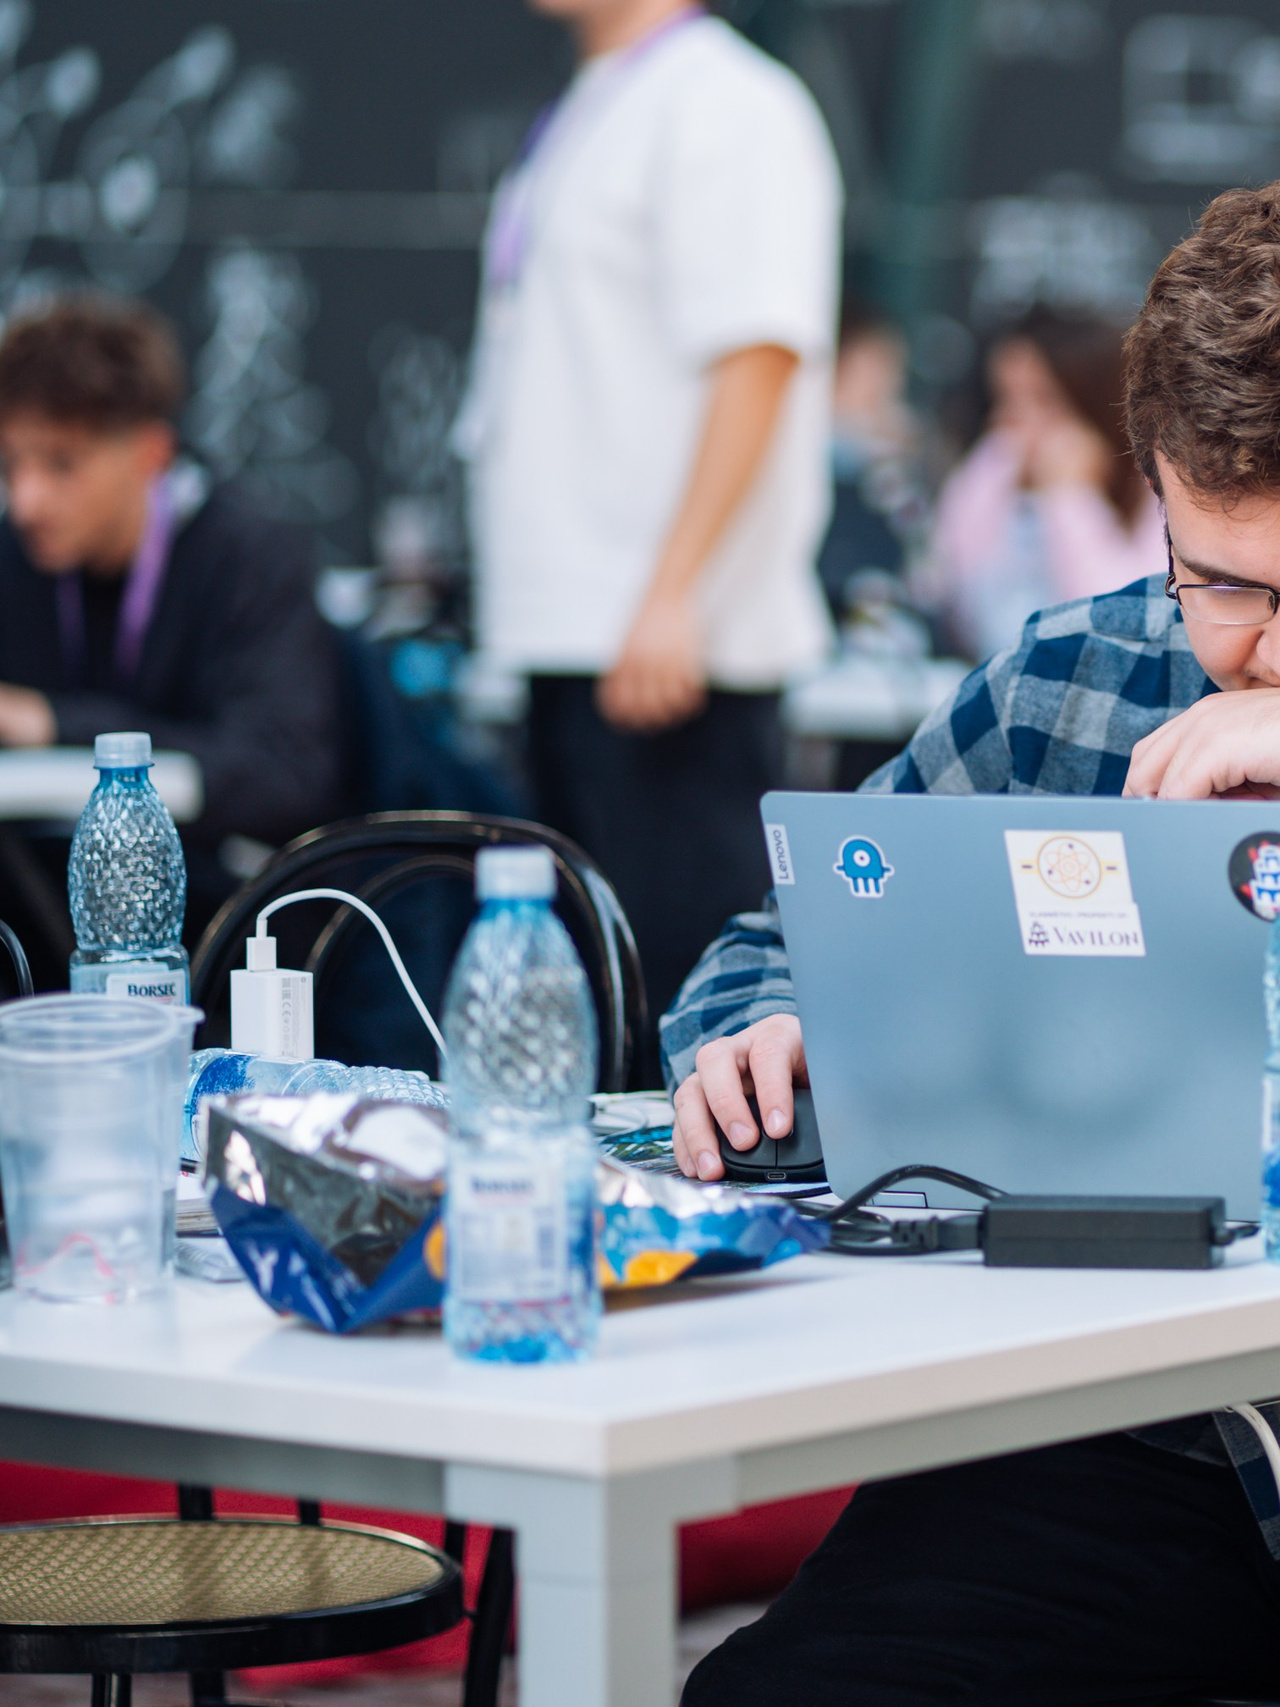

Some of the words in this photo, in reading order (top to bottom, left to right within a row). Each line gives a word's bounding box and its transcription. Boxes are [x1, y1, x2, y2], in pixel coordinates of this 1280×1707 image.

[773, 829, 789, 880] Lenovo
[1053, 926, 1139, 946] VAVILON
[127, 982, 176, 998] BORSEC
